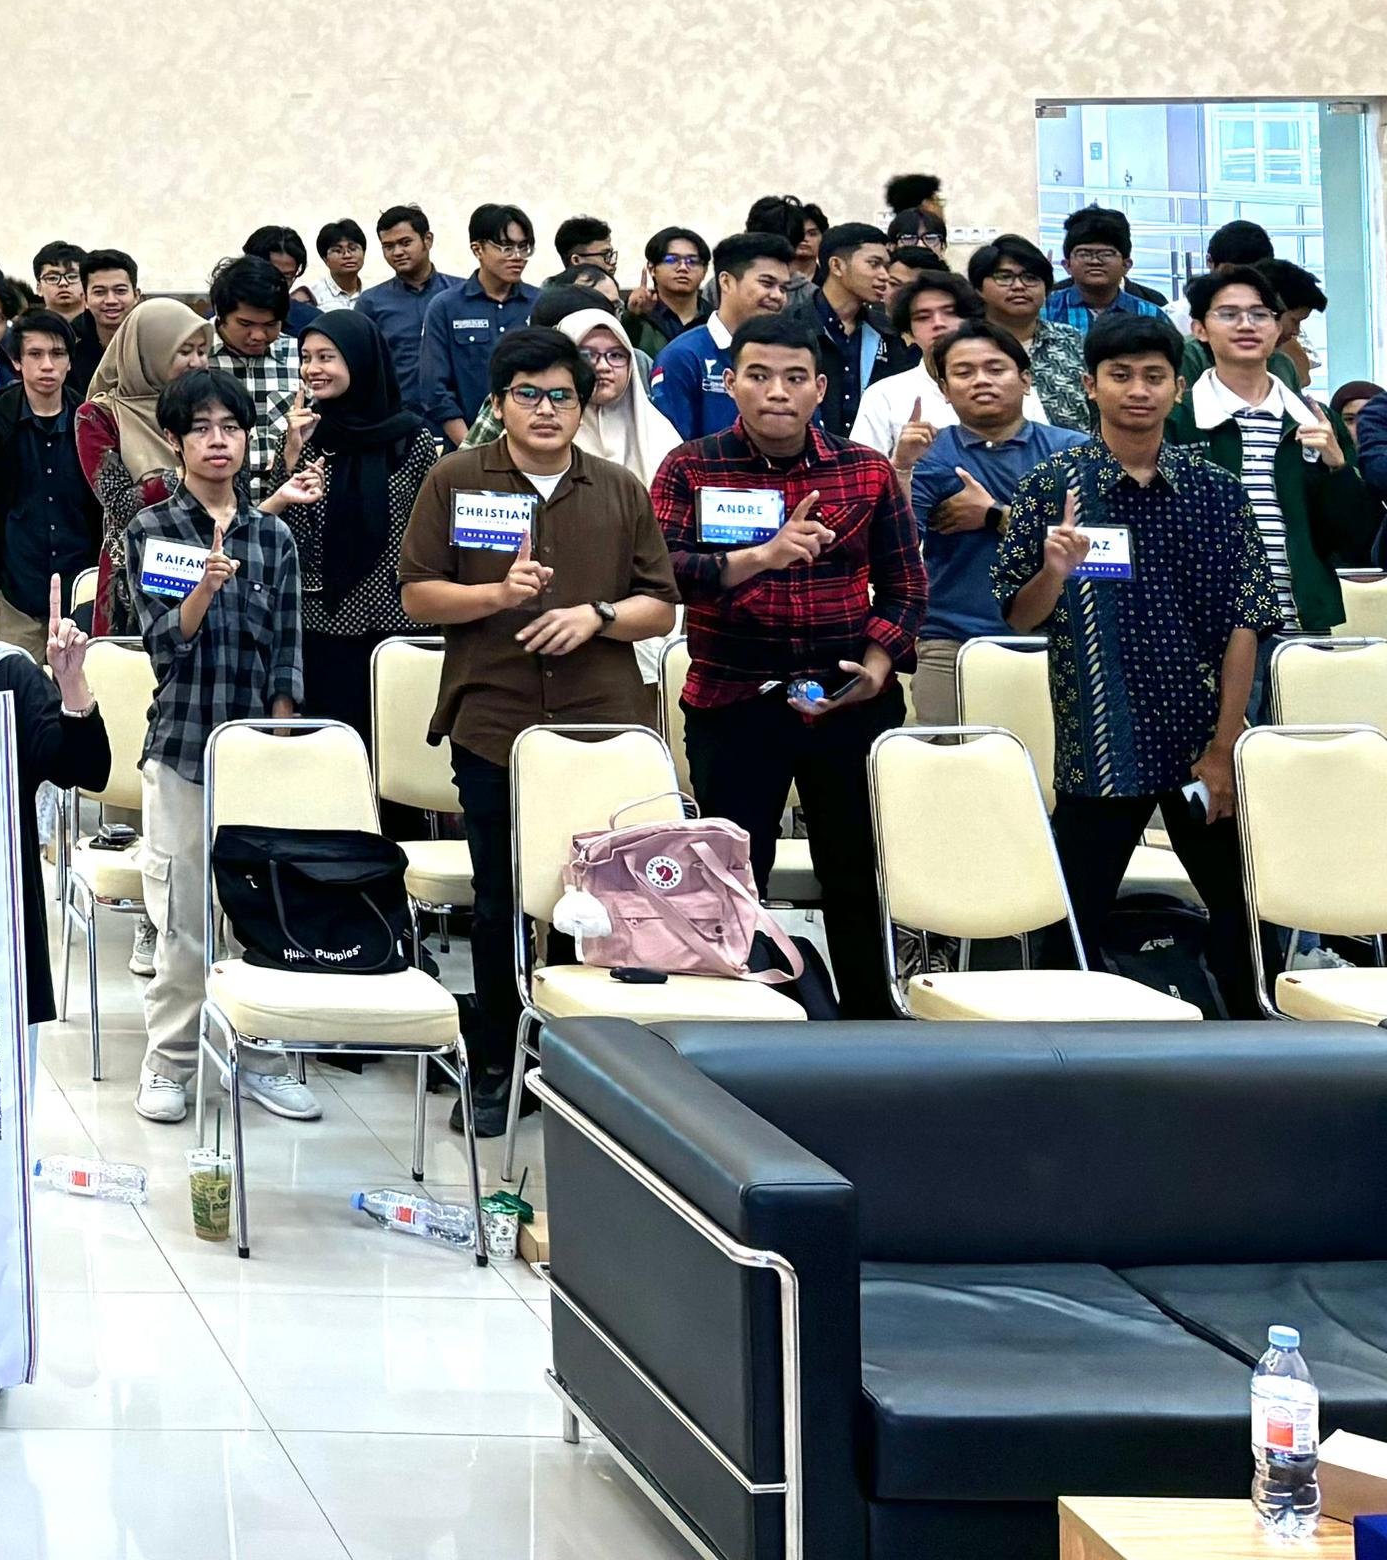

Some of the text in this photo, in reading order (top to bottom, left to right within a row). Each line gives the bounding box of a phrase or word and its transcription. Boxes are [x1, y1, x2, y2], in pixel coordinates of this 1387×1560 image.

[457, 506, 530, 520] CHRISTIAN
[716, 504, 764, 515] ANDRE
[1091, 540, 1111, 551] AZ
[156, 552, 205, 570] RAIFAN
[283, 948, 311, 962] Hus
